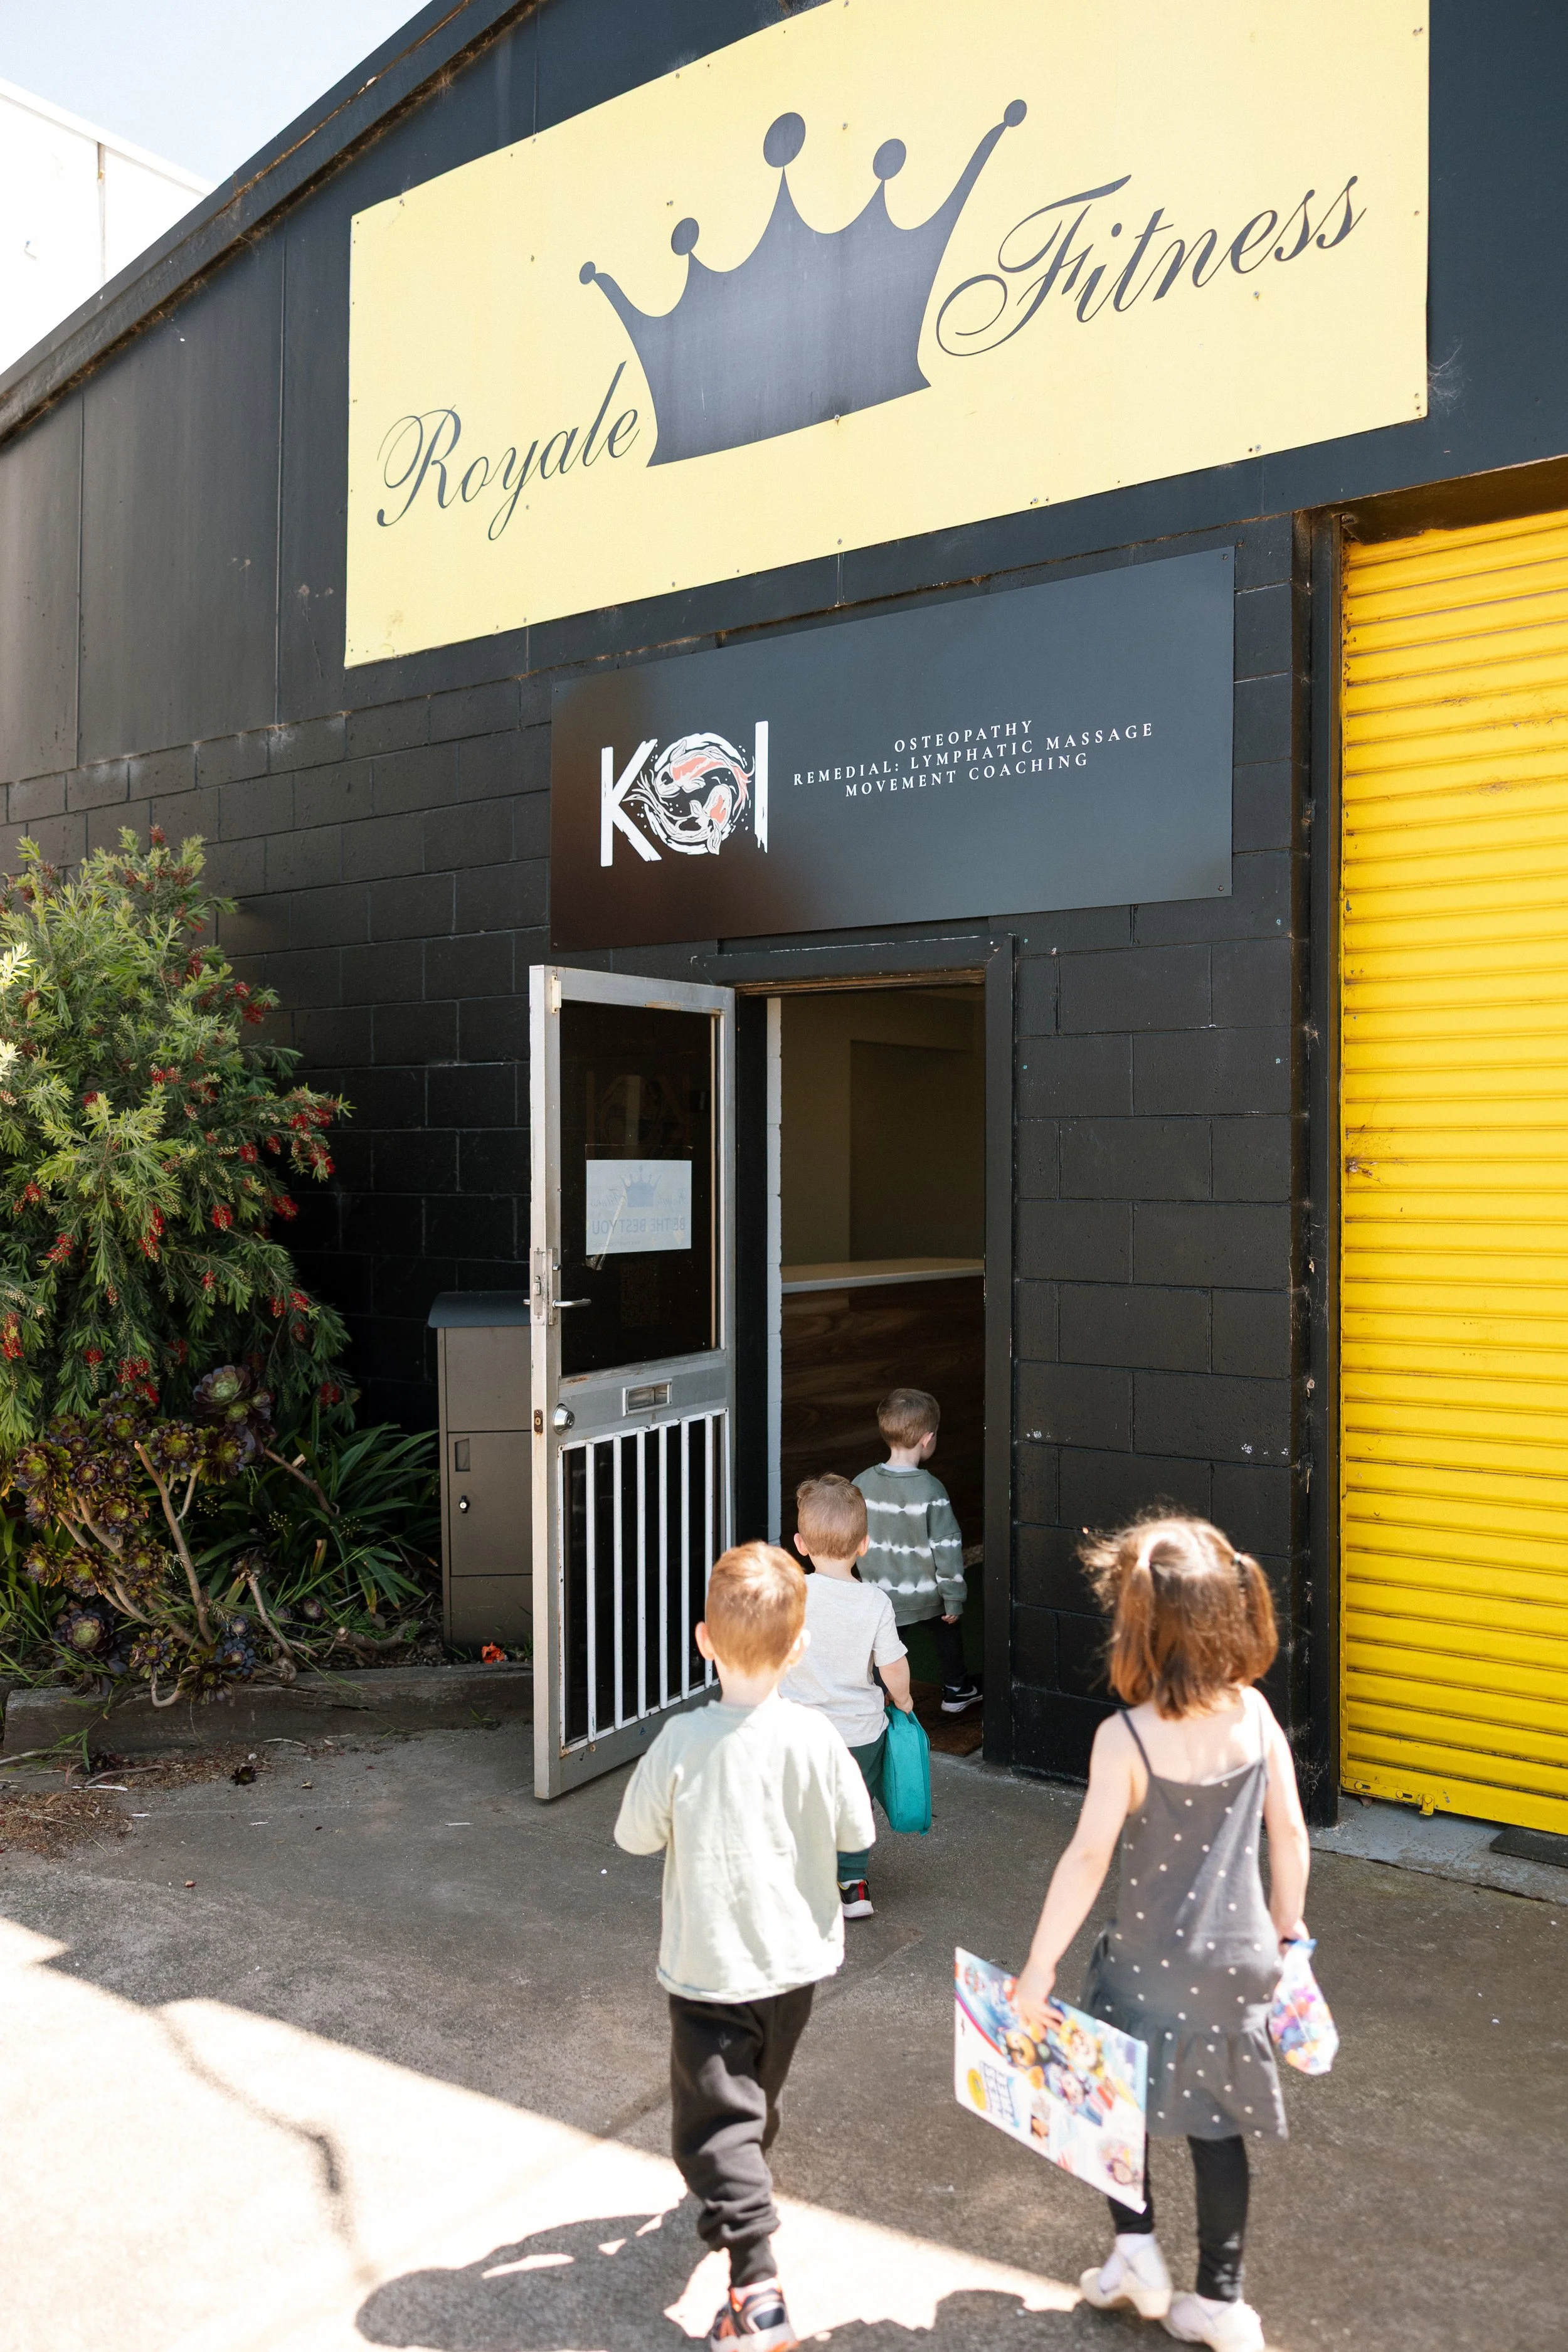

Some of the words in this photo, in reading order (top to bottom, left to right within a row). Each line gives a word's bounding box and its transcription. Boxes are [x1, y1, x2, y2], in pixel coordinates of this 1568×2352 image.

[376, 360, 640, 541] Royale
[936, 174, 1367, 357] Fitness
[793, 760, 900, 786] REMEDIAL:
[910, 739, 1033, 770] LYMPHATIC
[1046, 723, 1153, 751] MASSAGE
[894, 720, 1032, 753] OSTEOPATHY
[600, 720, 769, 867] KOI
[845, 770, 956, 797] MOVEMENT
[968, 752, 1088, 780] COACHING
